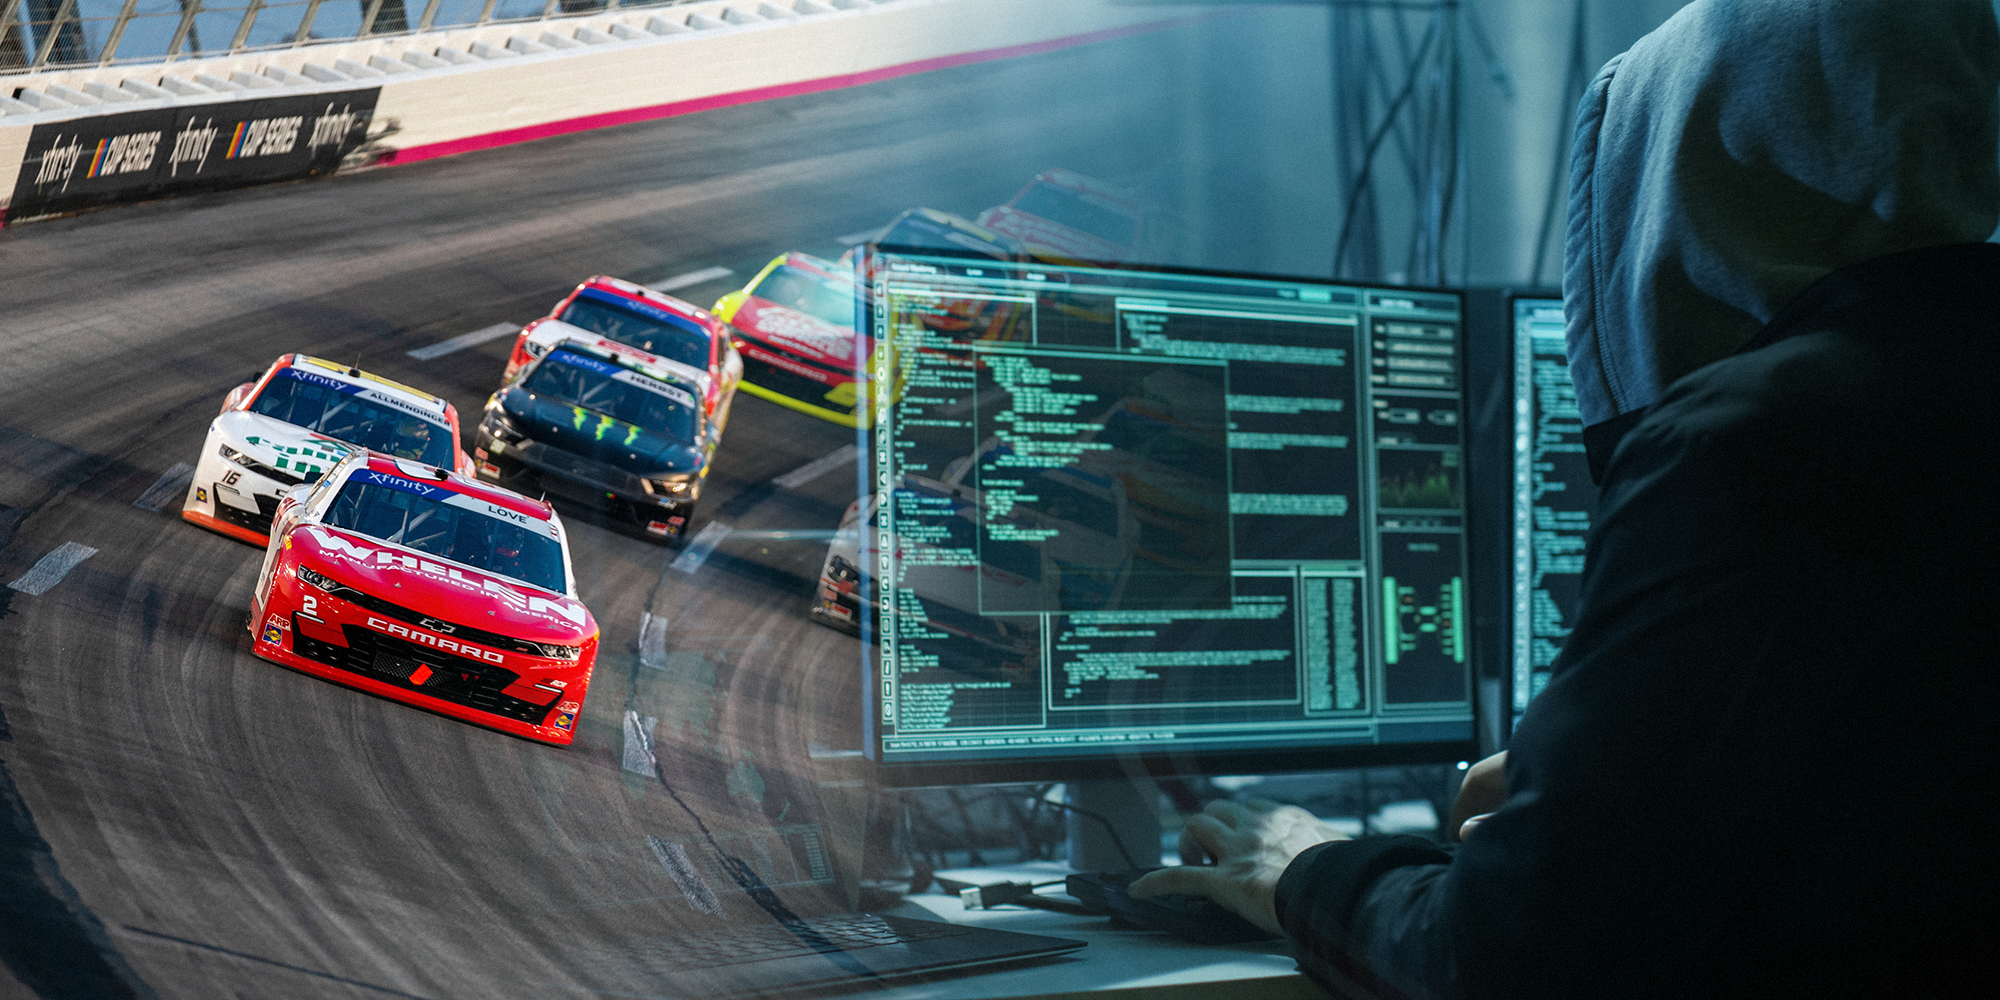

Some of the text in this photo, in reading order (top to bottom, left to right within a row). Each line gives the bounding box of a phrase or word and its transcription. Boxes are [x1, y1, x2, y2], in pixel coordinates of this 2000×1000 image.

[34, 132, 84, 194] xfinity
[100, 134, 130, 177] CUP
[119, 129, 162, 174] SERIES
[168, 115, 219, 178] xfinity
[239, 118, 270, 158] CUP
[259, 115, 304, 156] SERIES
[291, 369, 451, 428] xfinity ALLMENDINGER
[630, 375, 685, 399] HERBST
[222, 469, 242, 486] 16
[368, 472, 528, 525] xfinity LOVE
[305, 527, 587, 628] WHELEN
[318, 549, 585, 636] MANUFACTURED IN AMERICA
[303, 594, 318, 616] 2
[366, 616, 505, 664] CAMARO
